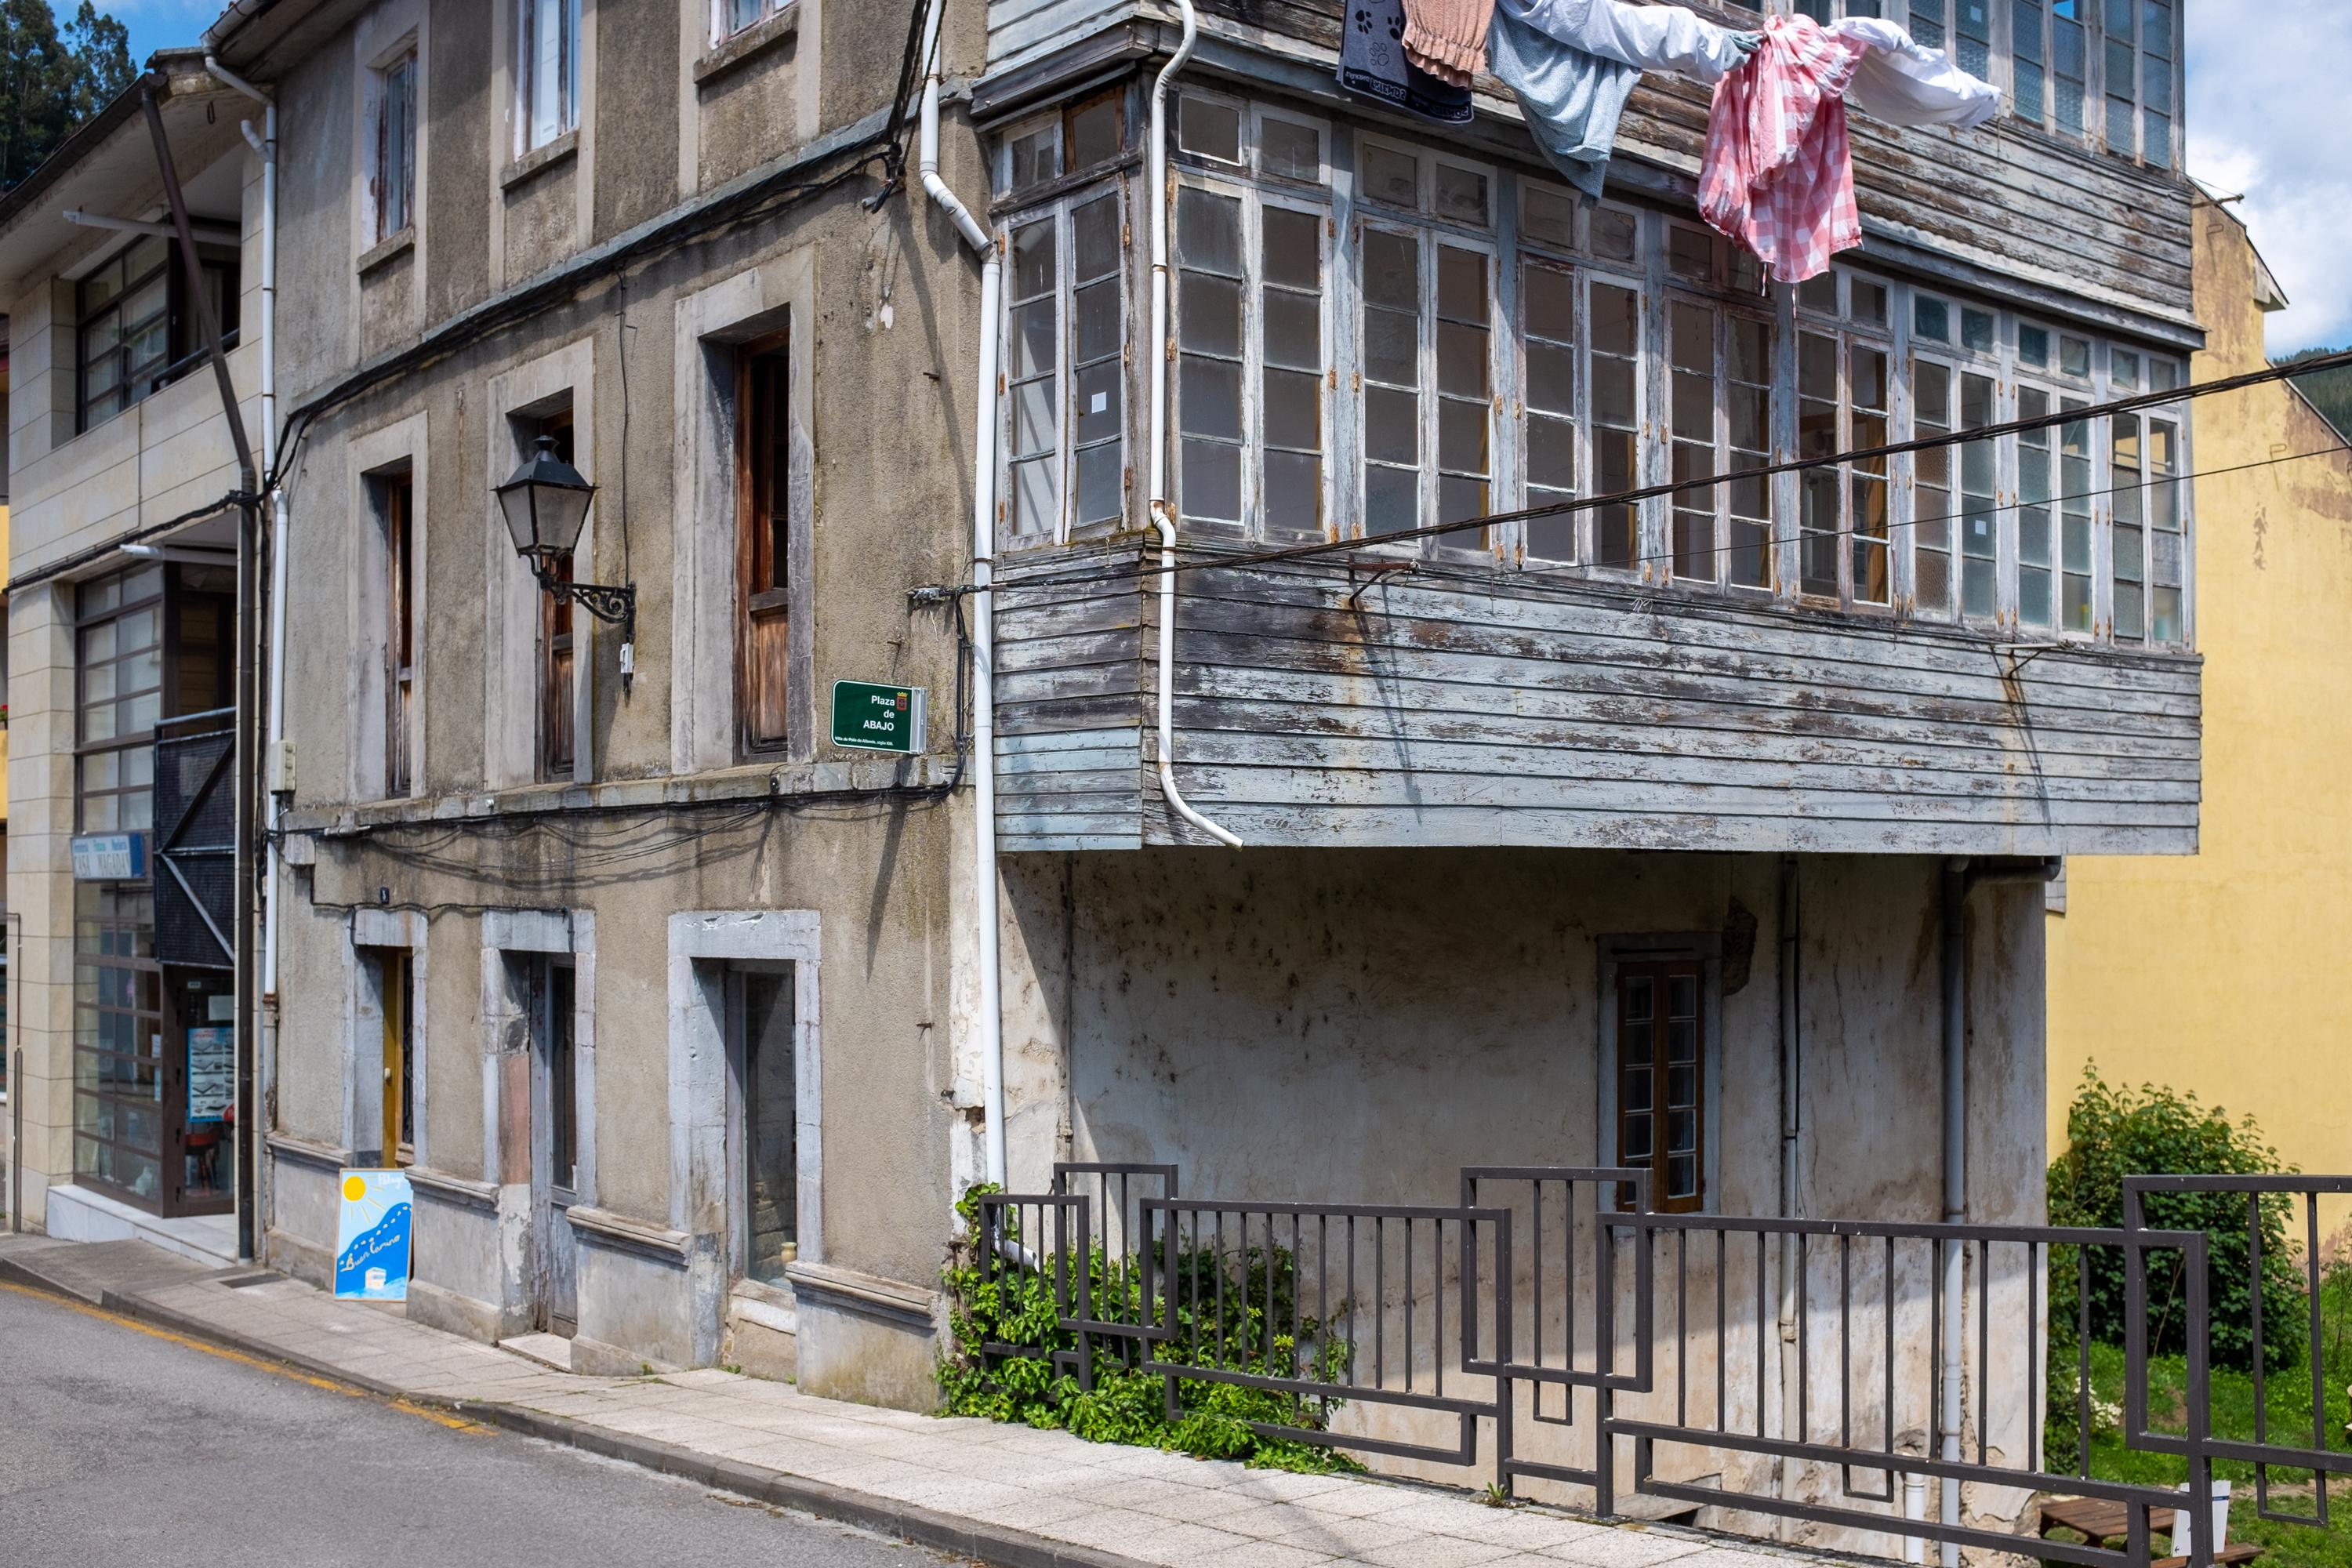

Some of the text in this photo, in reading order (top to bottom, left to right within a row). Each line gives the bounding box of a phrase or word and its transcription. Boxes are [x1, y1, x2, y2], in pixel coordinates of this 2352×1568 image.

[871, 695, 895, 706] Plaza
[884, 710, 895, 719] de
[863, 720, 894, 731] ABAJO
[74, 854, 91, 878] CASA
[340, 1252, 371, 1272] Buen
